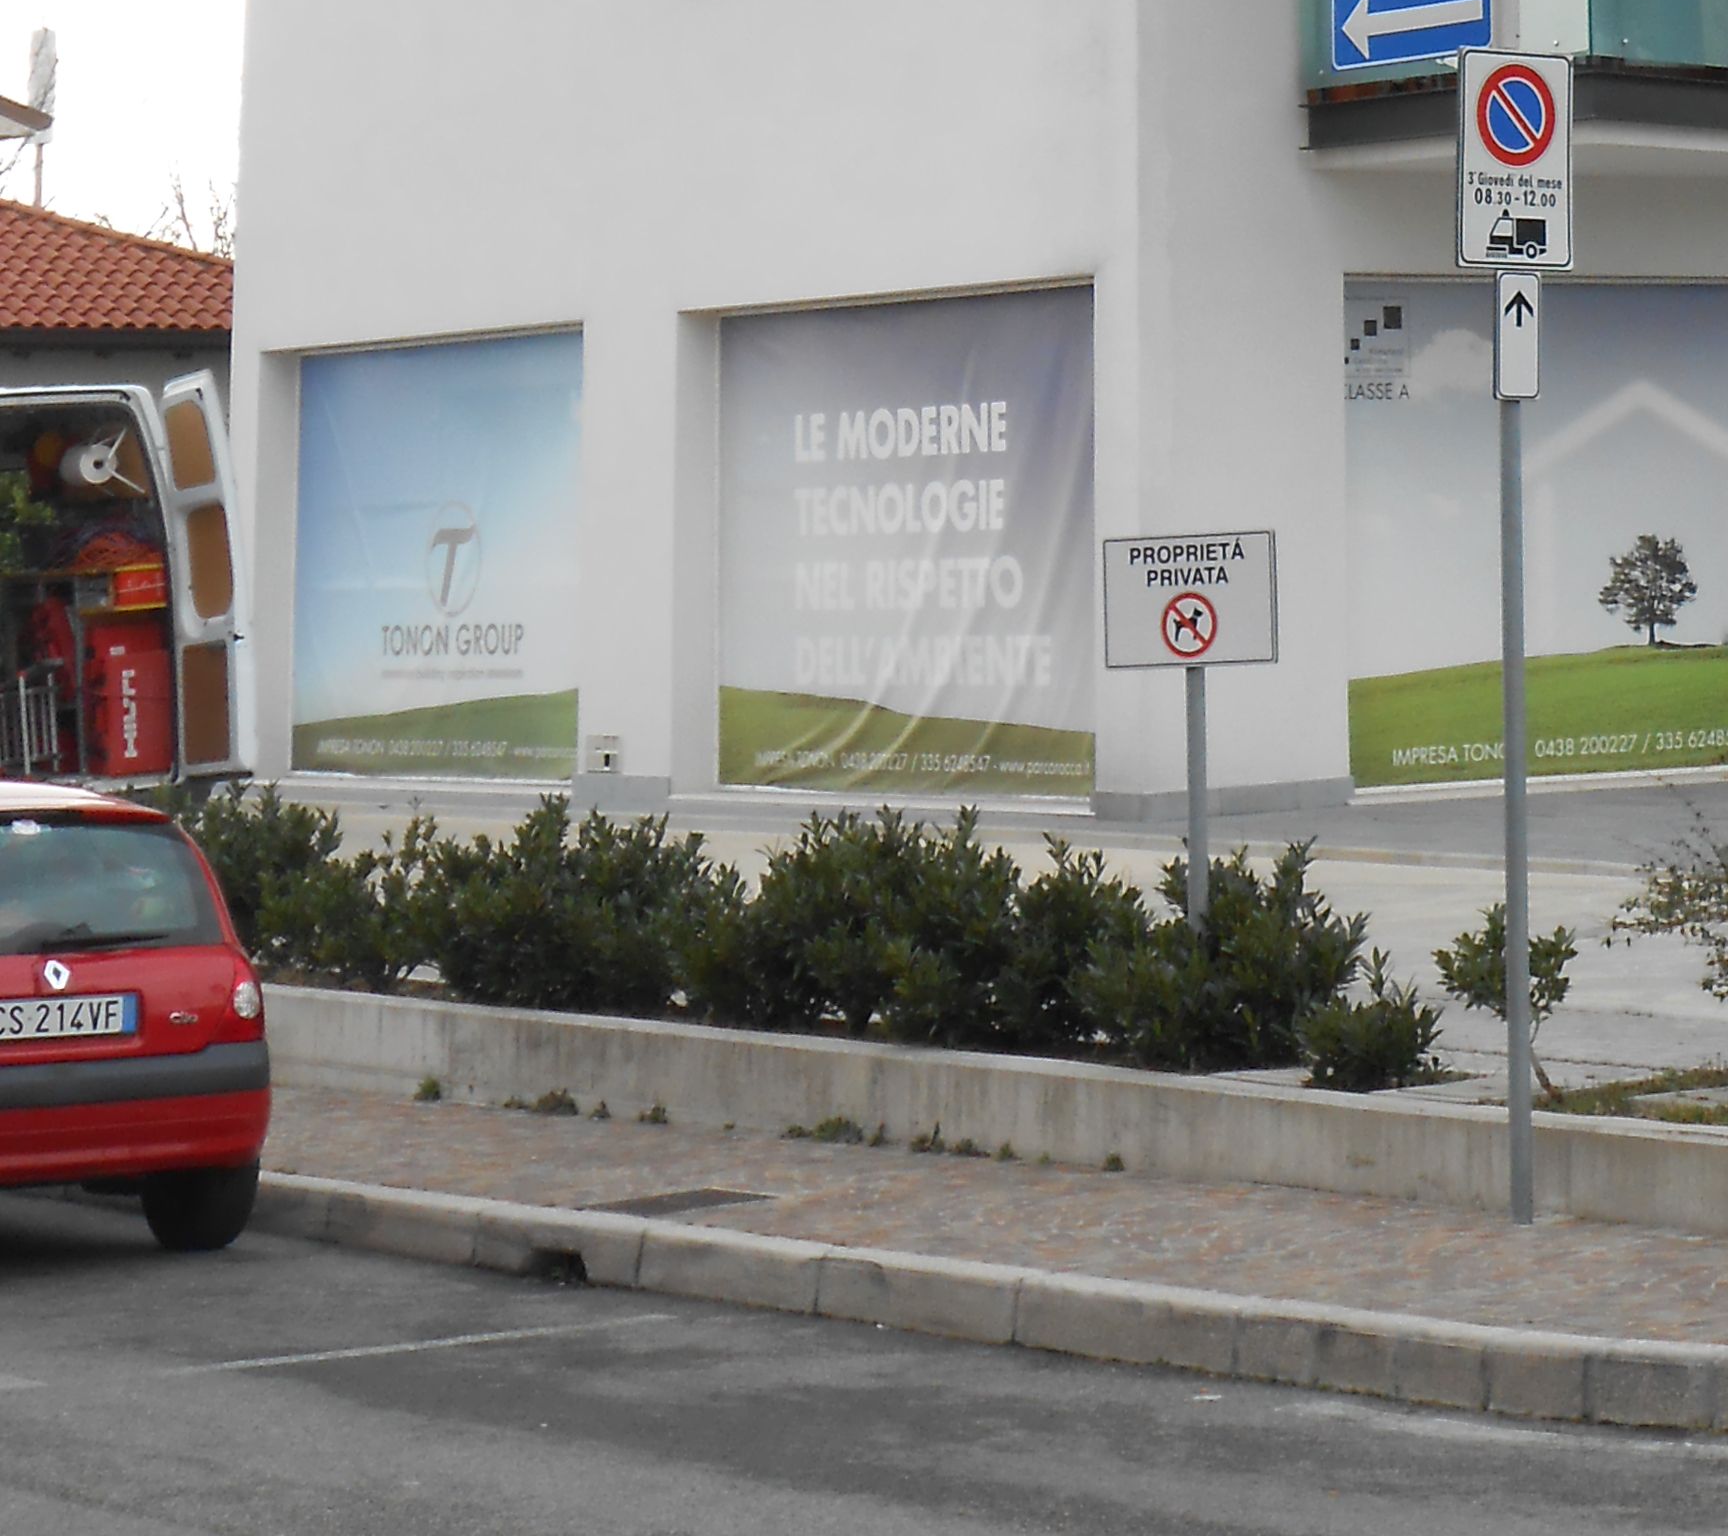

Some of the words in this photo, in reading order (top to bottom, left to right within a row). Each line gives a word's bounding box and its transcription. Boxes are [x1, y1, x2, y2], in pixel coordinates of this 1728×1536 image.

[1518, 174, 1533, 188] del
[1537, 178, 1562, 189] mese
[1399, 384, 1409, 400] A
[795, 413, 826, 462] LE
[837, 401, 1007, 460] MODERNE
[795, 479, 1004, 535] TECNOLOGIE
[796, 561, 855, 610] NEL
[866, 555, 1023, 609] RISPETTO
[1146, 565, 1229, 587] PRIVATA
[381, 624, 449, 656] TONON
[455, 623, 524, 656] GROUP
[1392, 744, 1458, 766] IMPRESA
[1462, 742, 1505, 762] TON
[1534, 738, 1574, 757] 0438
[1580, 734, 1638, 755] 200227
[1656, 732, 1683, 751] 335
[35, 1000, 119, 1033] 214VF
